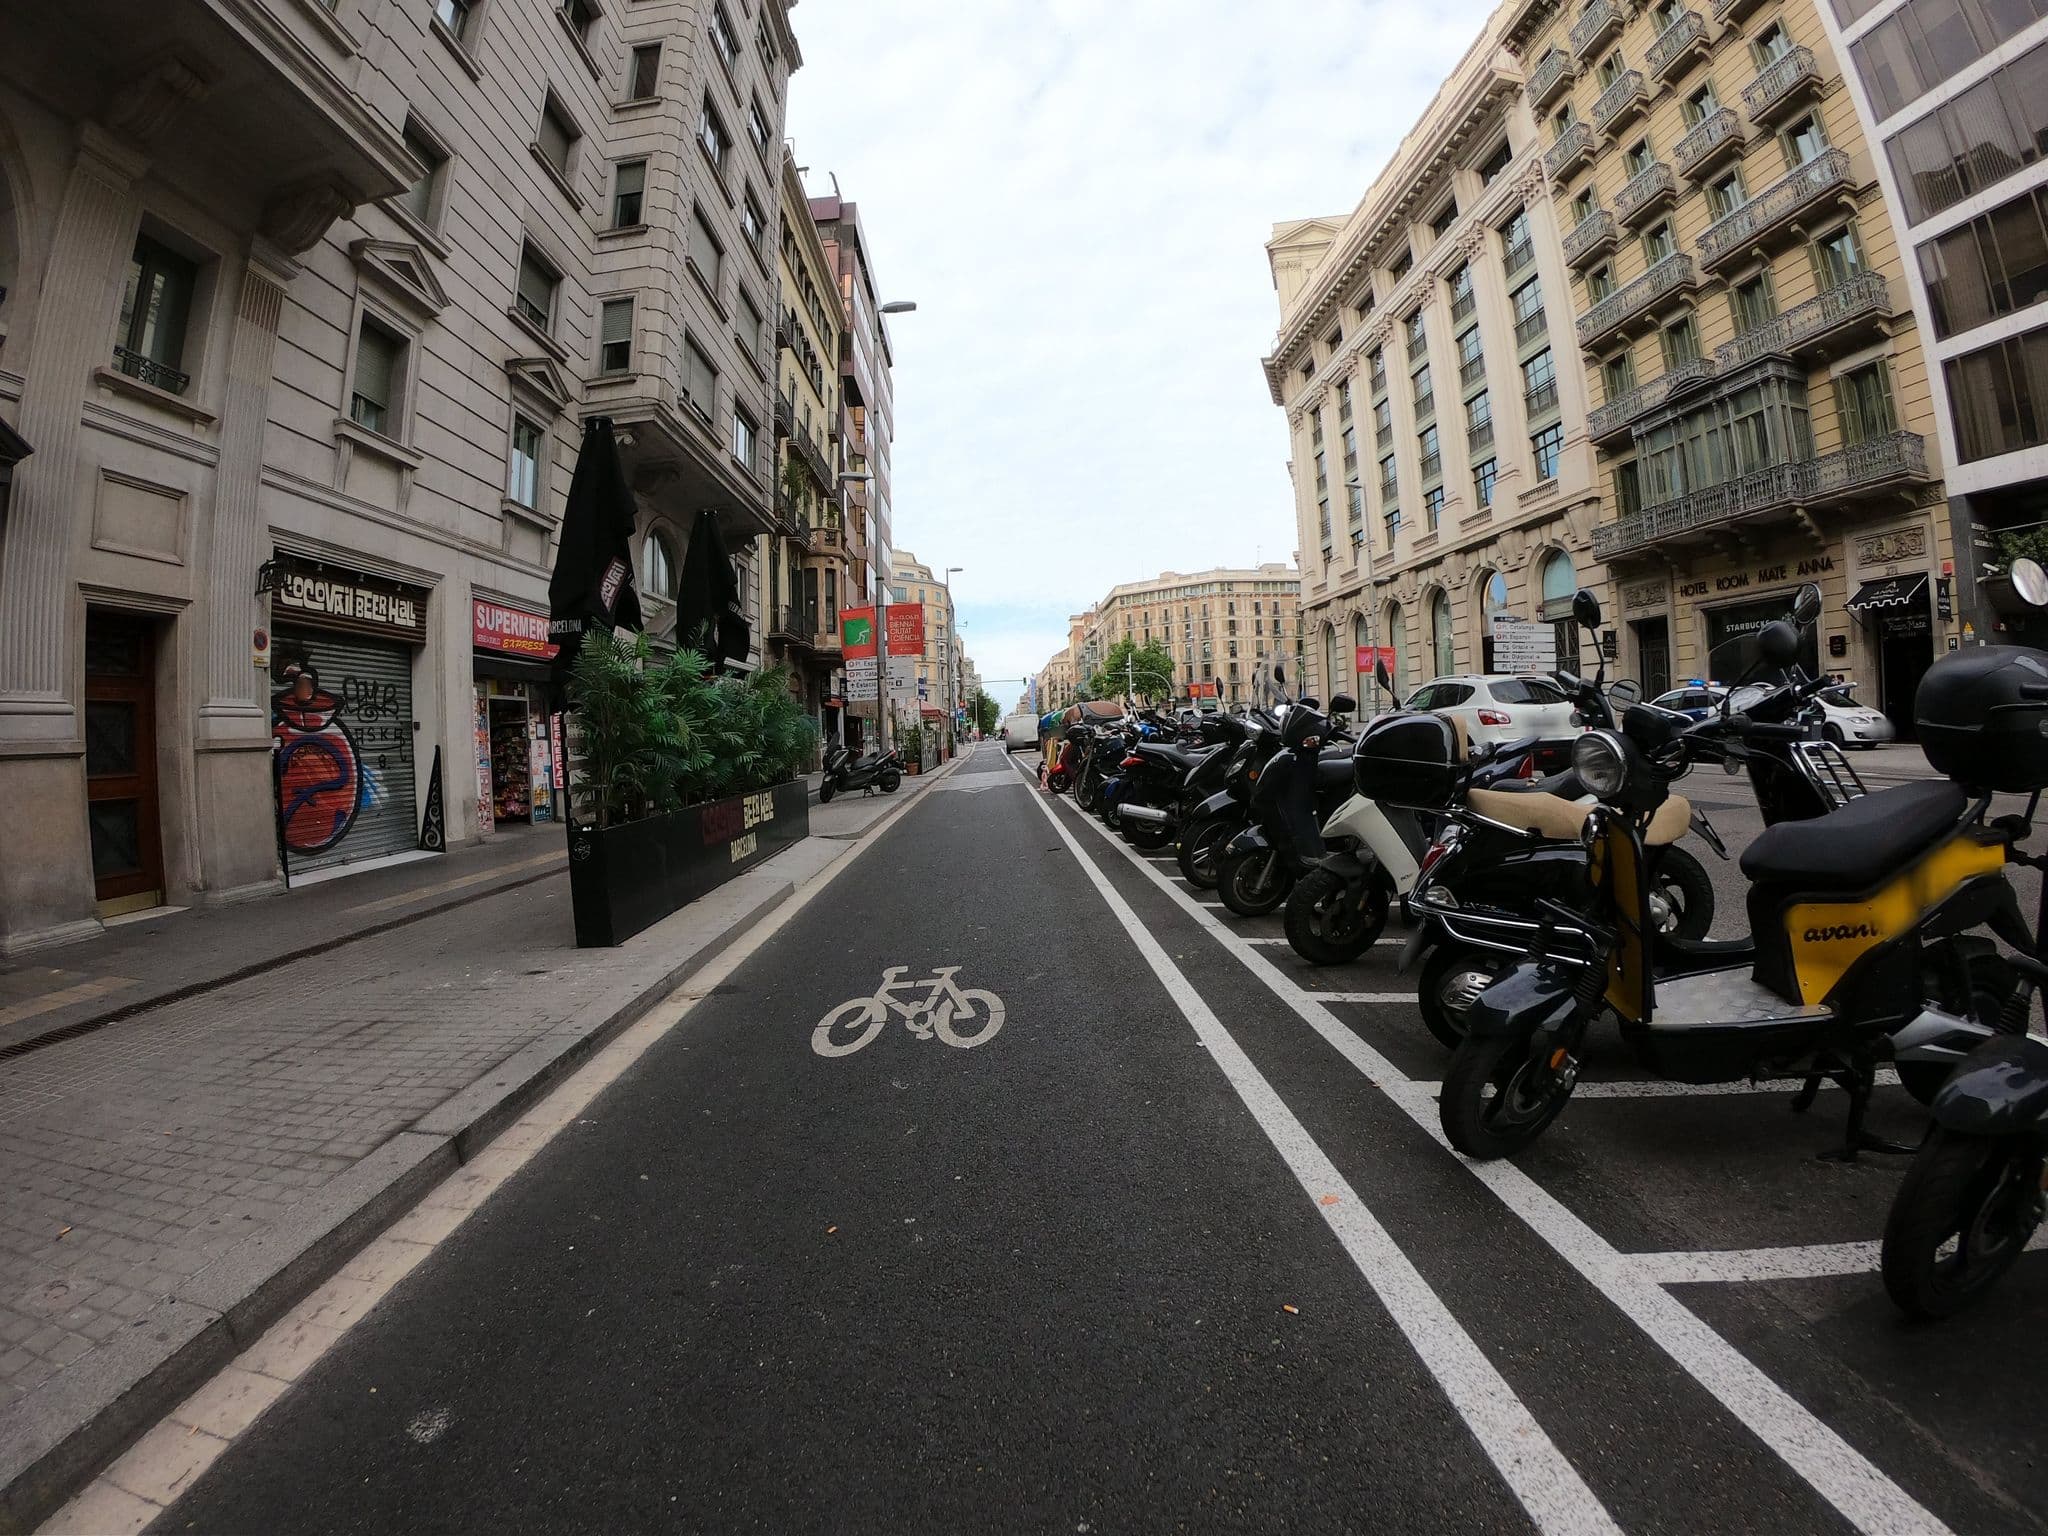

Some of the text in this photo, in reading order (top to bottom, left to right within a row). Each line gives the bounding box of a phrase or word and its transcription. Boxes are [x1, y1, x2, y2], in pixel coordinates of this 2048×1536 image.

[1680, 556, 1835, 597] HOTEL ROOM MATE ANNA
[356, 588, 387, 622] BEER
[477, 604, 550, 642] SUPERMERC
[889, 620, 915, 629] BIENNAL
[890, 627, 912, 635] CIUTAT
[502, 638, 545, 651] EXPRESS
